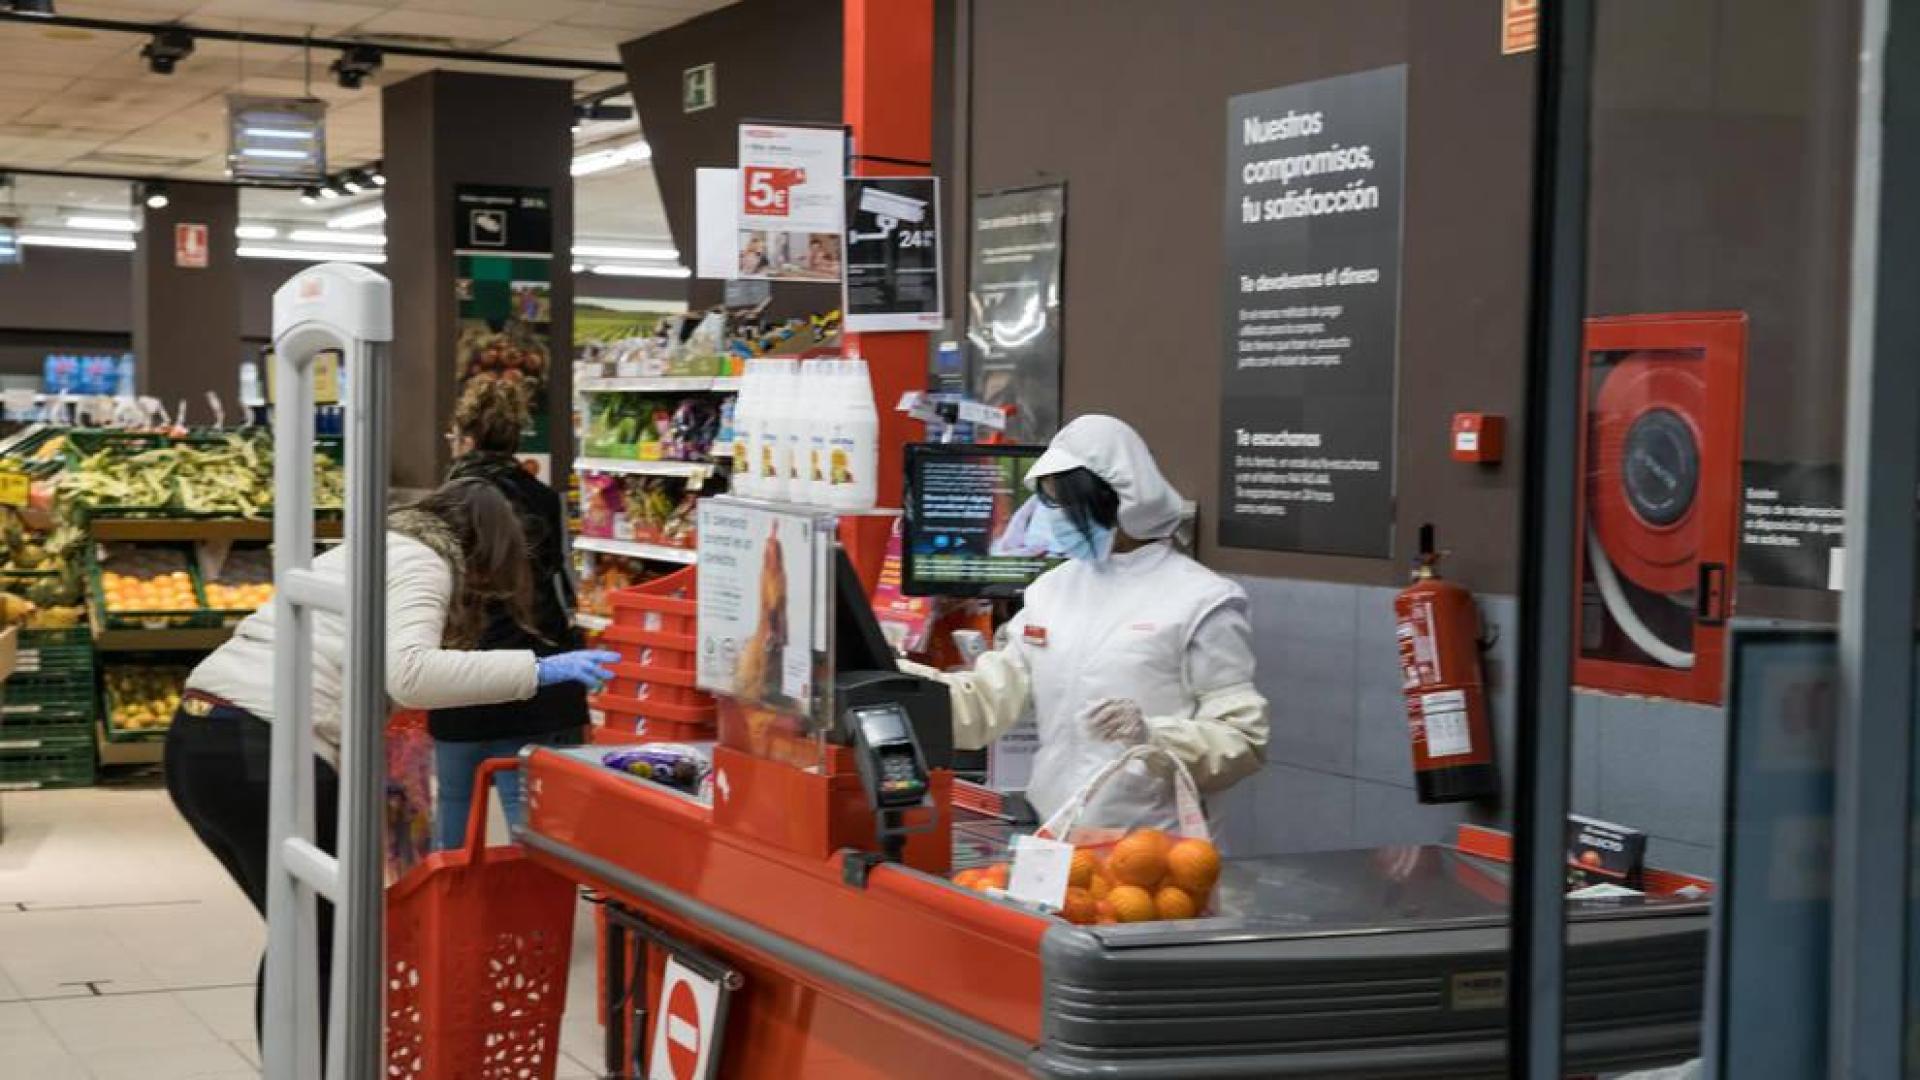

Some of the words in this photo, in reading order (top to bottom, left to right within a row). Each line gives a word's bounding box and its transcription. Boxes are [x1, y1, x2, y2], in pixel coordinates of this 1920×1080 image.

[1244, 110, 1323, 146] Nuestros
[1243, 144, 1375, 185] compromisos,
[1242, 196, 1261, 223] tu
[1264, 179, 1379, 220] satisfacción
